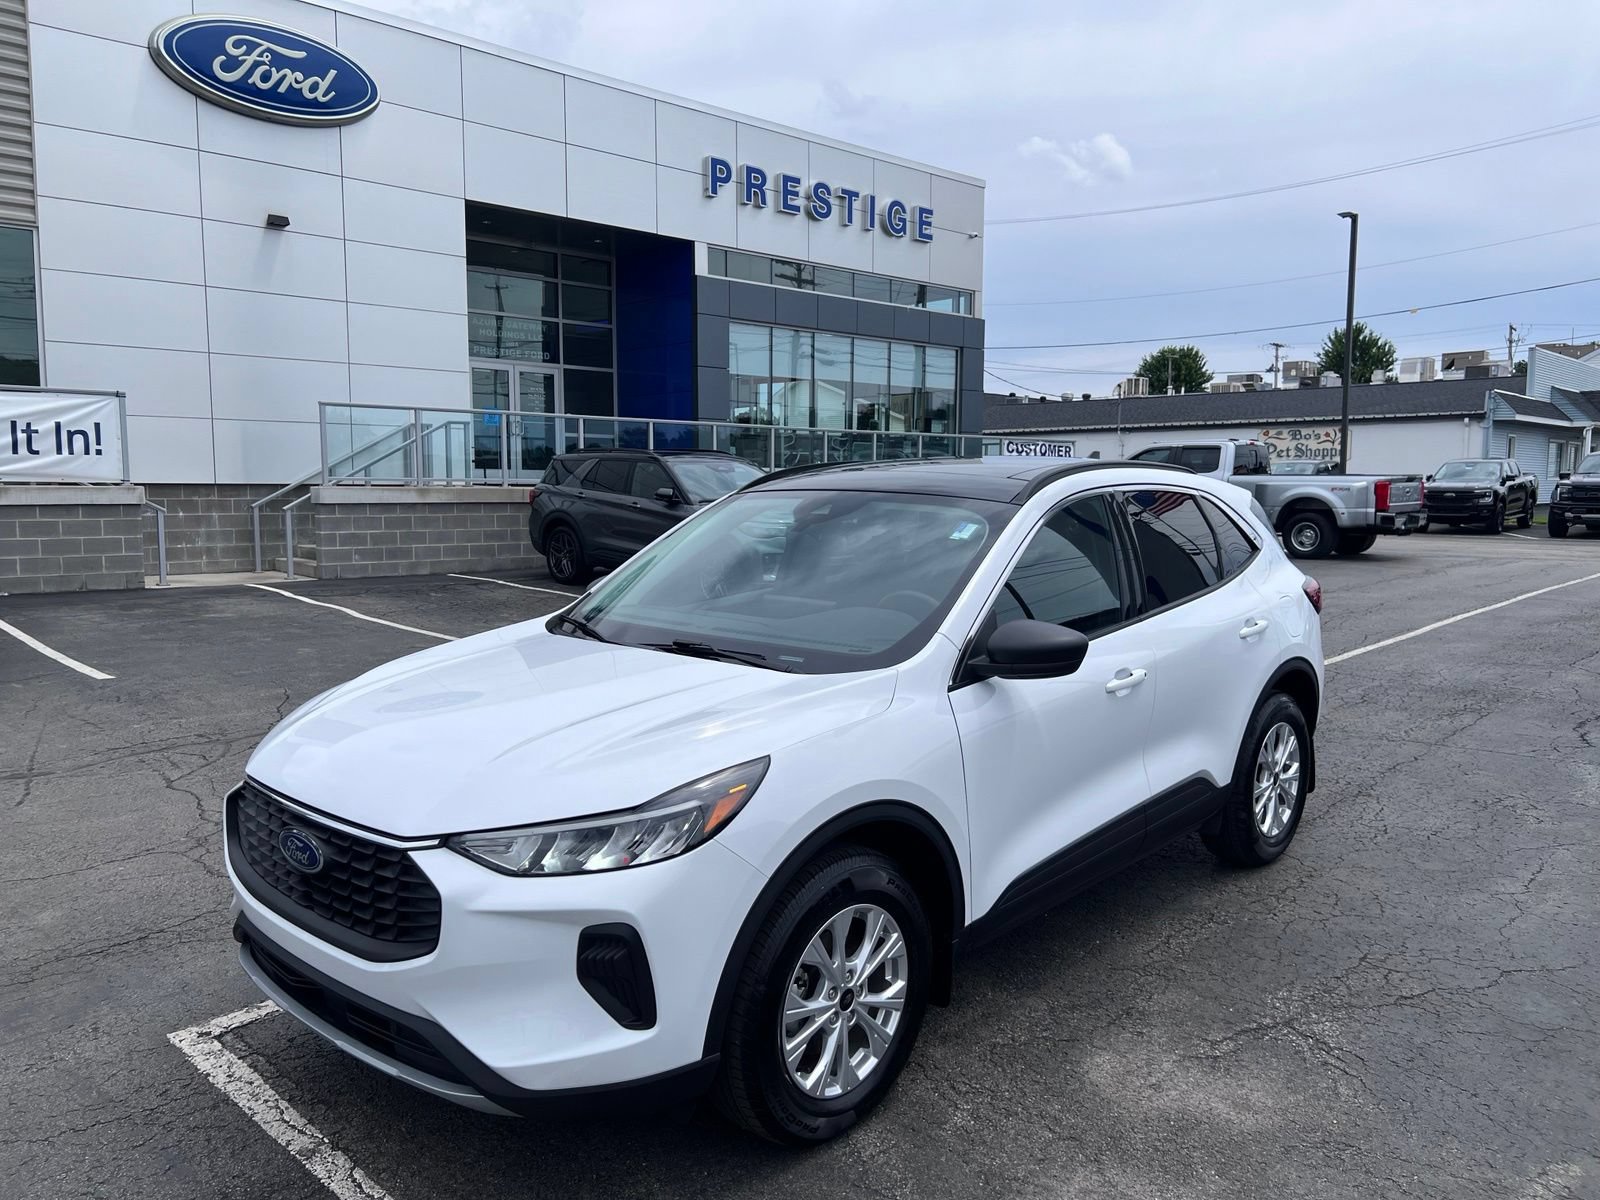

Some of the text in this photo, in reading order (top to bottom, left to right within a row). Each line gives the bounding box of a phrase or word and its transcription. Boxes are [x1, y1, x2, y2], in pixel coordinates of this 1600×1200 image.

[212, 34, 337, 104] Ford
[704, 154, 935, 243] PRESTIGE
[479, 328, 544, 342] HOLDINGS LLC
[473, 345, 551, 360] PRESTIGE FORD
[10, 420, 103, 456] It In!
[1288, 429, 1321, 441] Bo's
[1006, 441, 1072, 458] CUSTOMER
[1265, 442, 1341, 460] Pet Shopp
